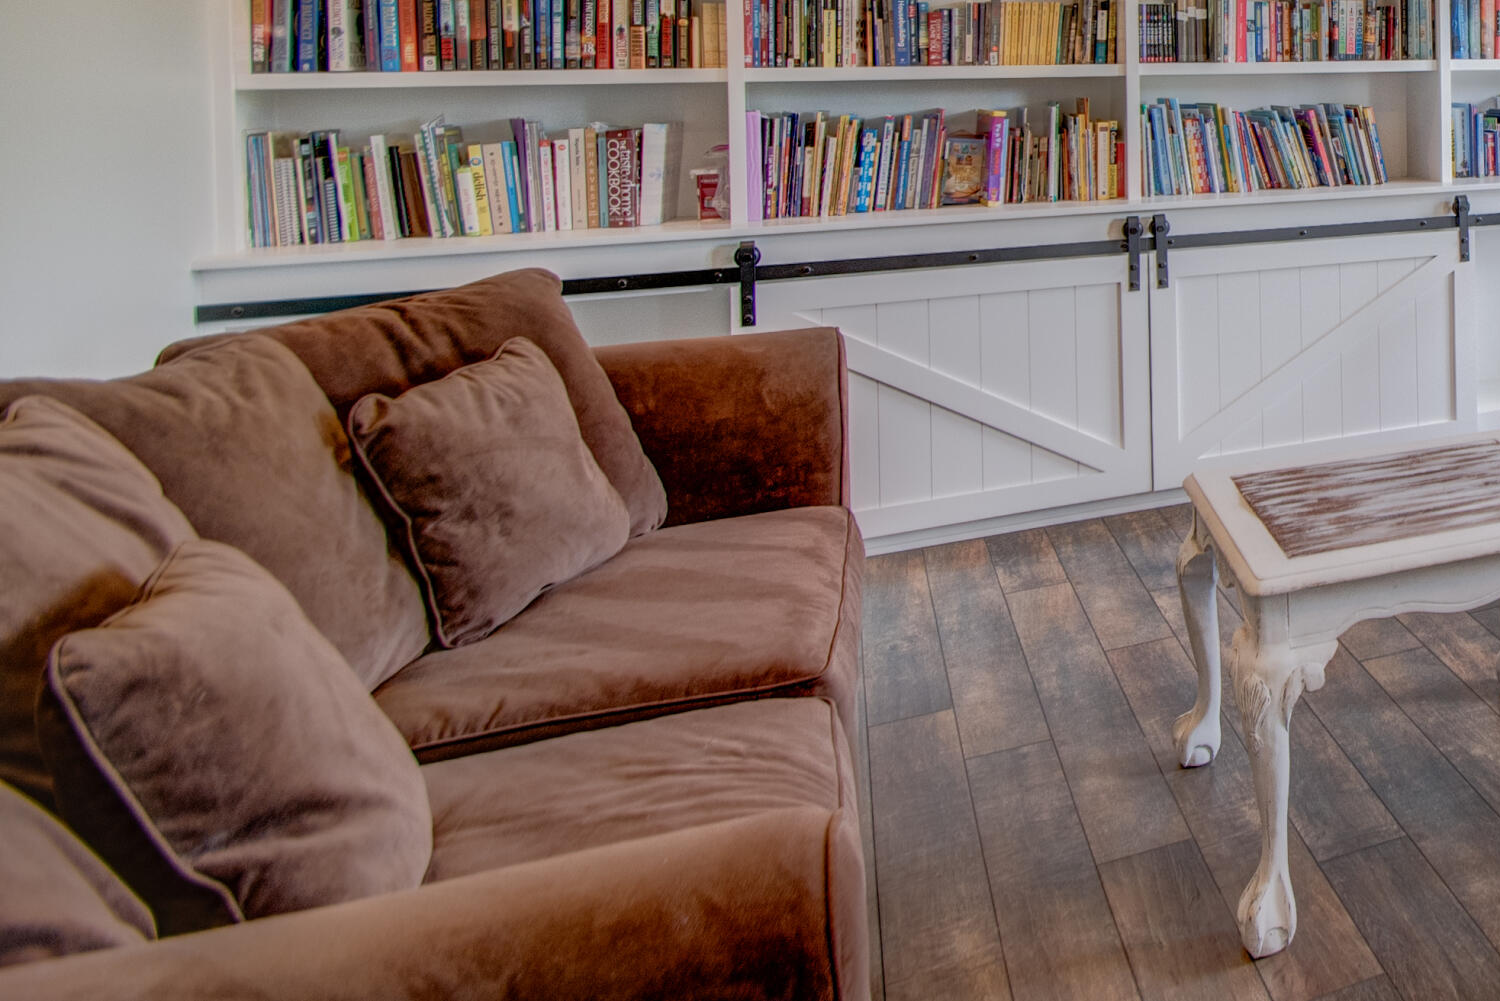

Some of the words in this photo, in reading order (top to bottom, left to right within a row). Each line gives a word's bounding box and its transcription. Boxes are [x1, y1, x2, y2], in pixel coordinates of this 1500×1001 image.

[301, 4, 313, 40] BALDACCI
[384, 5, 397, 46] BALDACCI
[422, 2, 435, 33] BALDACCI
[584, 2, 594, 37] PATTERSON
[895, 0, 906, 47] Housebuilding
[607, 139, 621, 216] COOKBOOK
[620, 150, 632, 175] taste
[473, 172, 486, 201] delish
[621, 184, 636, 216] home
